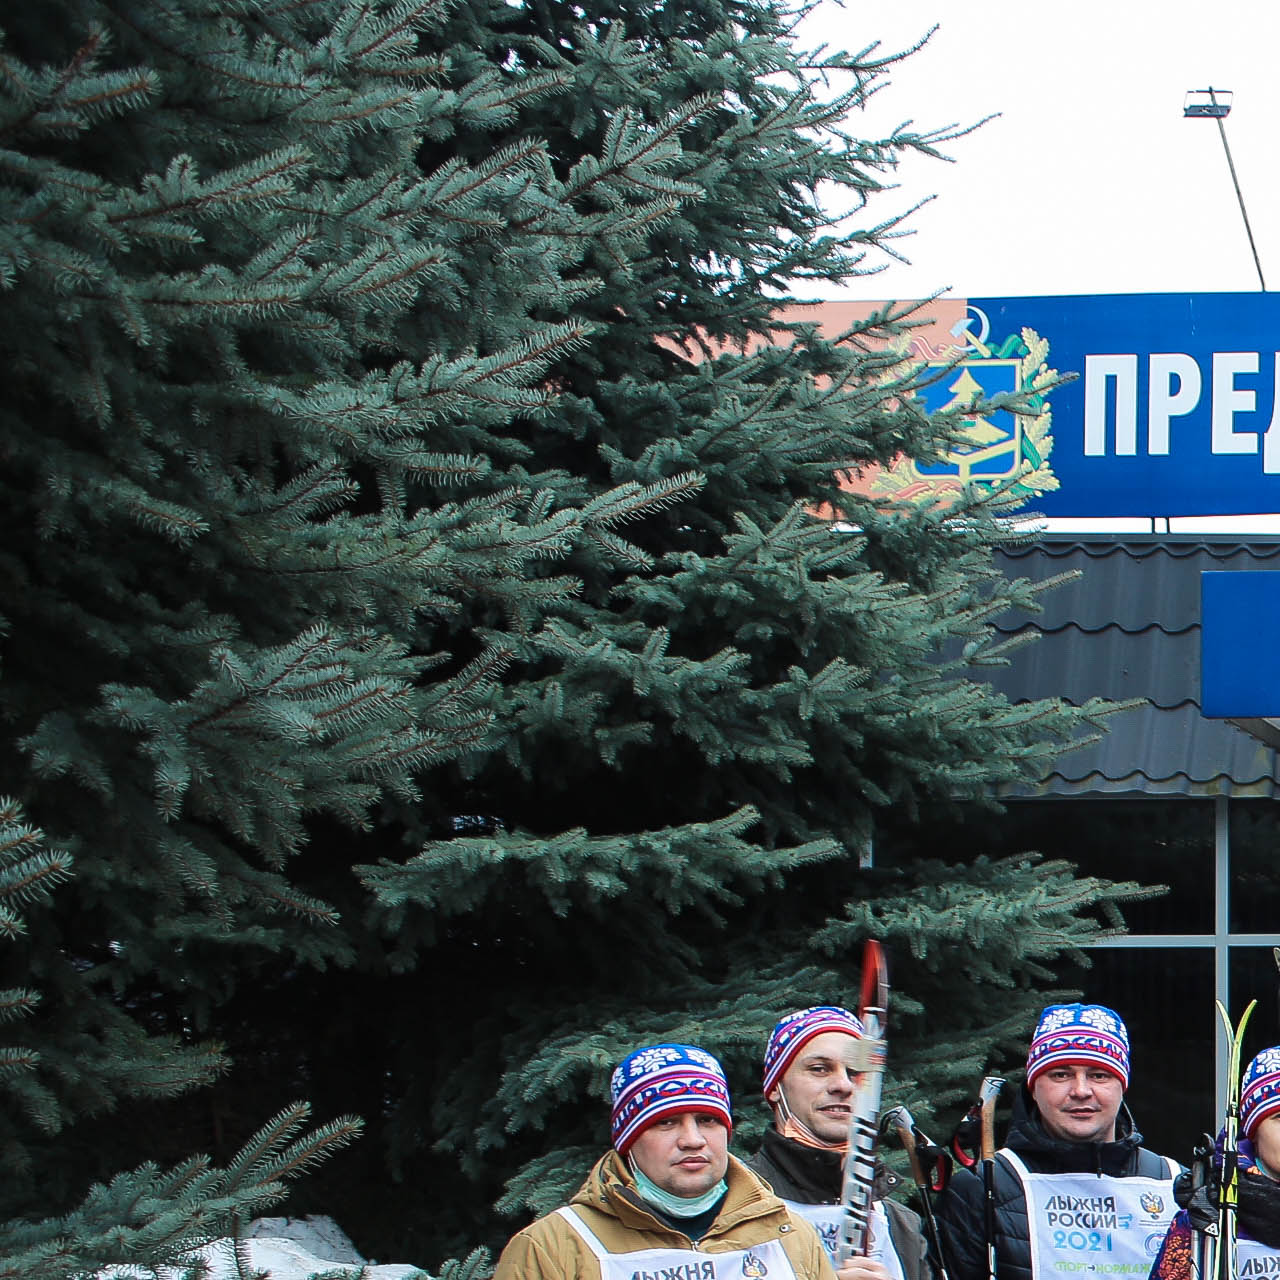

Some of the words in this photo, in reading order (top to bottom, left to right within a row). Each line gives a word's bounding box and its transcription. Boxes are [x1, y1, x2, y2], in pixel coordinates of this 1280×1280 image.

[1045, 1196, 1115, 1212] ЛЫЖНЯ
[1048, 1212, 1118, 1229] РОССИИ
[1054, 1232, 1112, 1251] 2021
